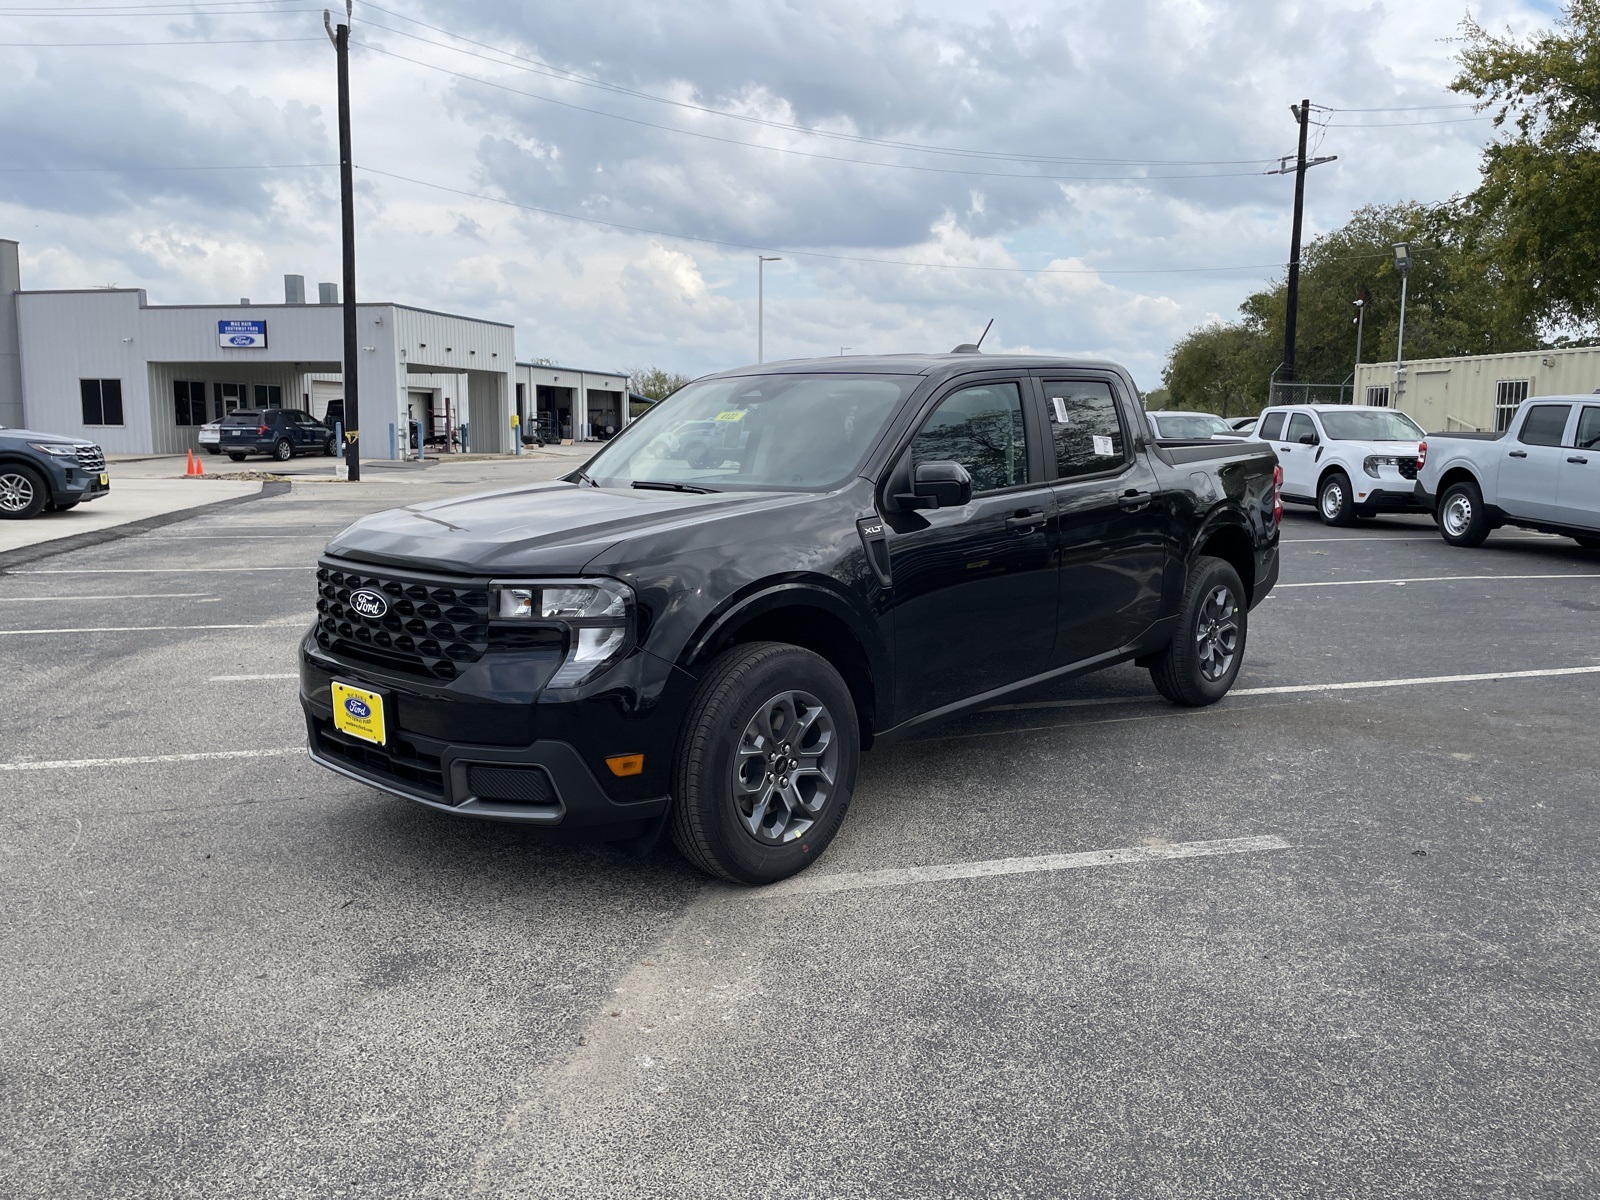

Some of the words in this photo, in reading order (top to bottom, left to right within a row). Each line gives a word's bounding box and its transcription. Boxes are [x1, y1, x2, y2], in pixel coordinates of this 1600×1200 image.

[864, 525, 883, 535] XLT
[356, 593, 380, 614] Ford
[349, 700, 366, 716] Ford
